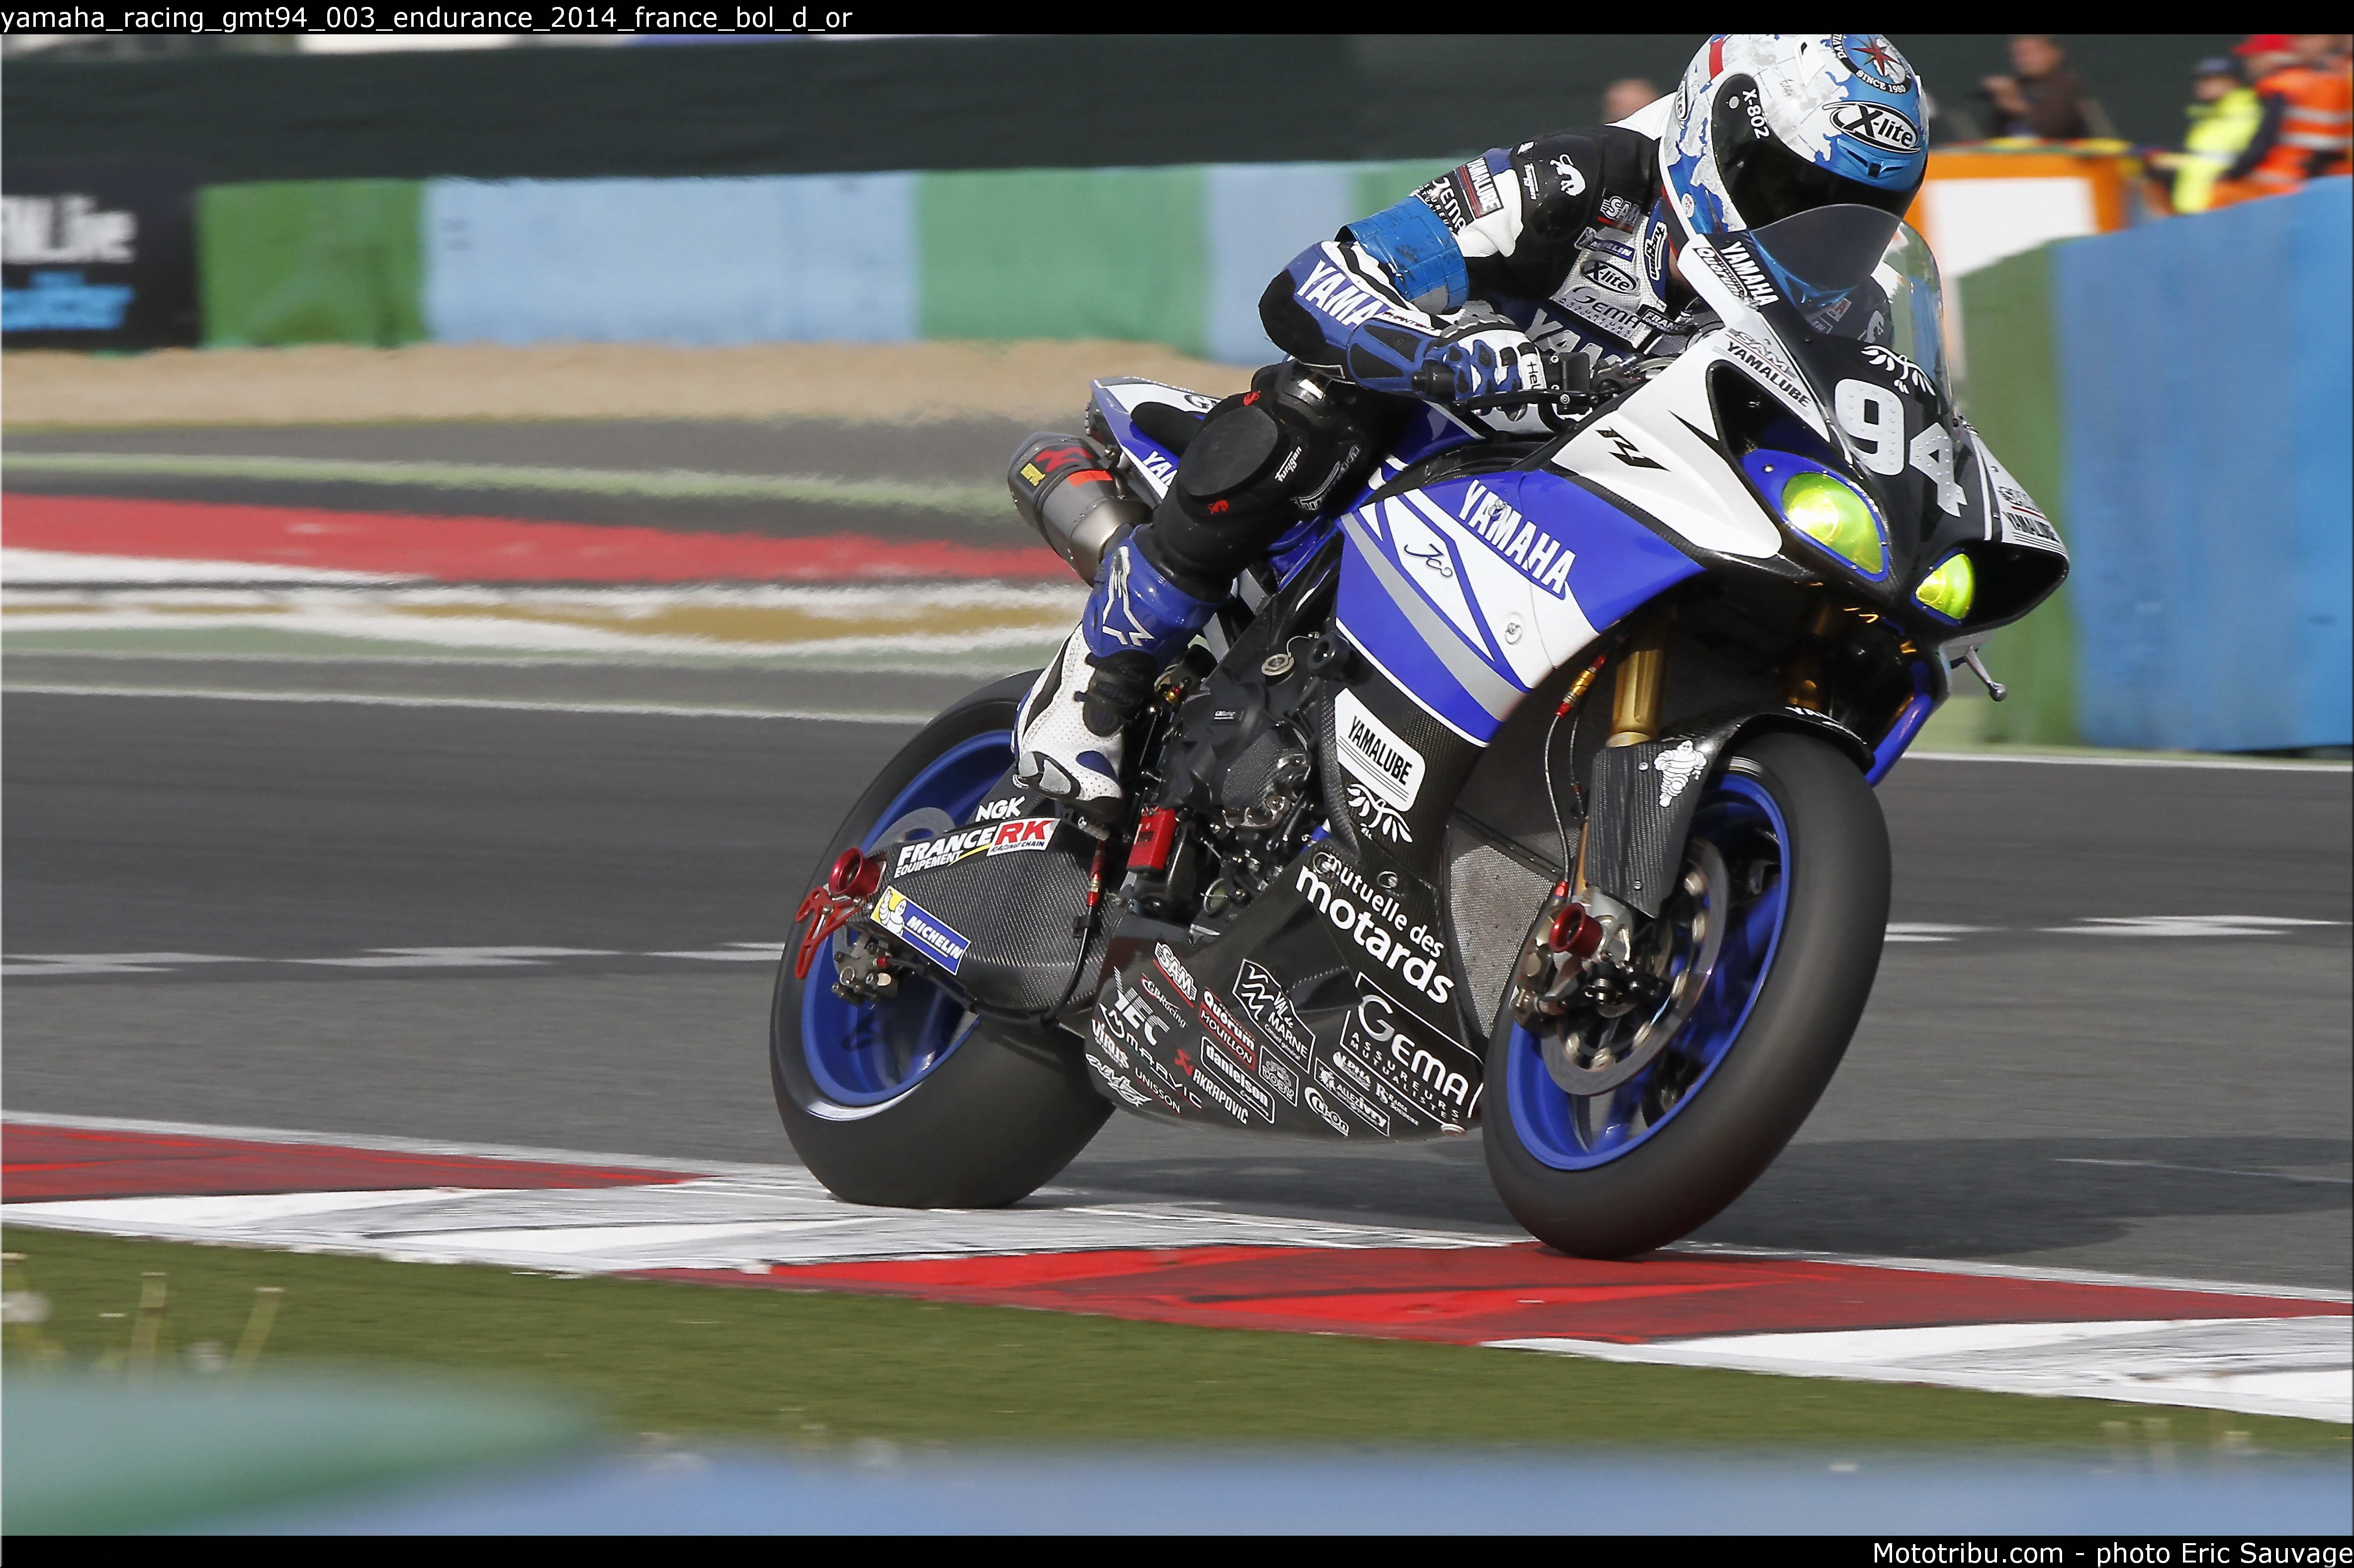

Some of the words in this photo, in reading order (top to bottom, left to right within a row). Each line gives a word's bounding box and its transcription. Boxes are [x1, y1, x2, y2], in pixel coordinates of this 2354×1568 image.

[1856, 70, 1886, 90] SINCE
[1742, 88, 1770, 140] X-802
[1842, 103, 1914, 148] X-lite
[1466, 157, 1500, 212] YAMALUBE
[1602, 196, 1640, 226] SAM
[1583, 261, 1631, 292] X-lite
[1720, 241, 1780, 306] YAMAHA
[1572, 286, 1640, 329] GEMA
[1727, 341, 1811, 407] YAMALUBE
[1733, 331, 1791, 374] SAM
[1834, 378, 1968, 518] 94
[1457, 479, 1577, 595] YAMAHA
[1347, 715, 1412, 786] YAMALUBE
[975, 795, 1026, 822] NGK
[894, 850, 963, 879] EQUIPEMENT
[897, 826, 997, 866] FRANCE
[995, 820, 1055, 846] RK
[1326, 854, 1408, 932] mutuelle
[1409, 924, 1445, 958] des
[906, 915, 963, 960] MICHELIN
[1295, 865, 1455, 1004] motards
[1157, 943, 1196, 1001] SAM
[1147, 980, 1187, 1028] GBRacing
[1203, 990, 1255, 1051] Quorum
[1273, 991, 1288, 1021] VAL
[1284, 1017, 1294, 1029] de
[1201, 1009, 1253, 1064] MOUILLON
[1268, 1011, 1308, 1059] MARNE
[1358, 994, 1469, 1106] GEMA
[1135, 1067, 1180, 1114] UNISSON
[1206, 1045, 1268, 1108] danielson
[1350, 1039, 1458, 1124] MUTUALISTES
[1352, 1032, 1459, 1119] ASSUREURS
